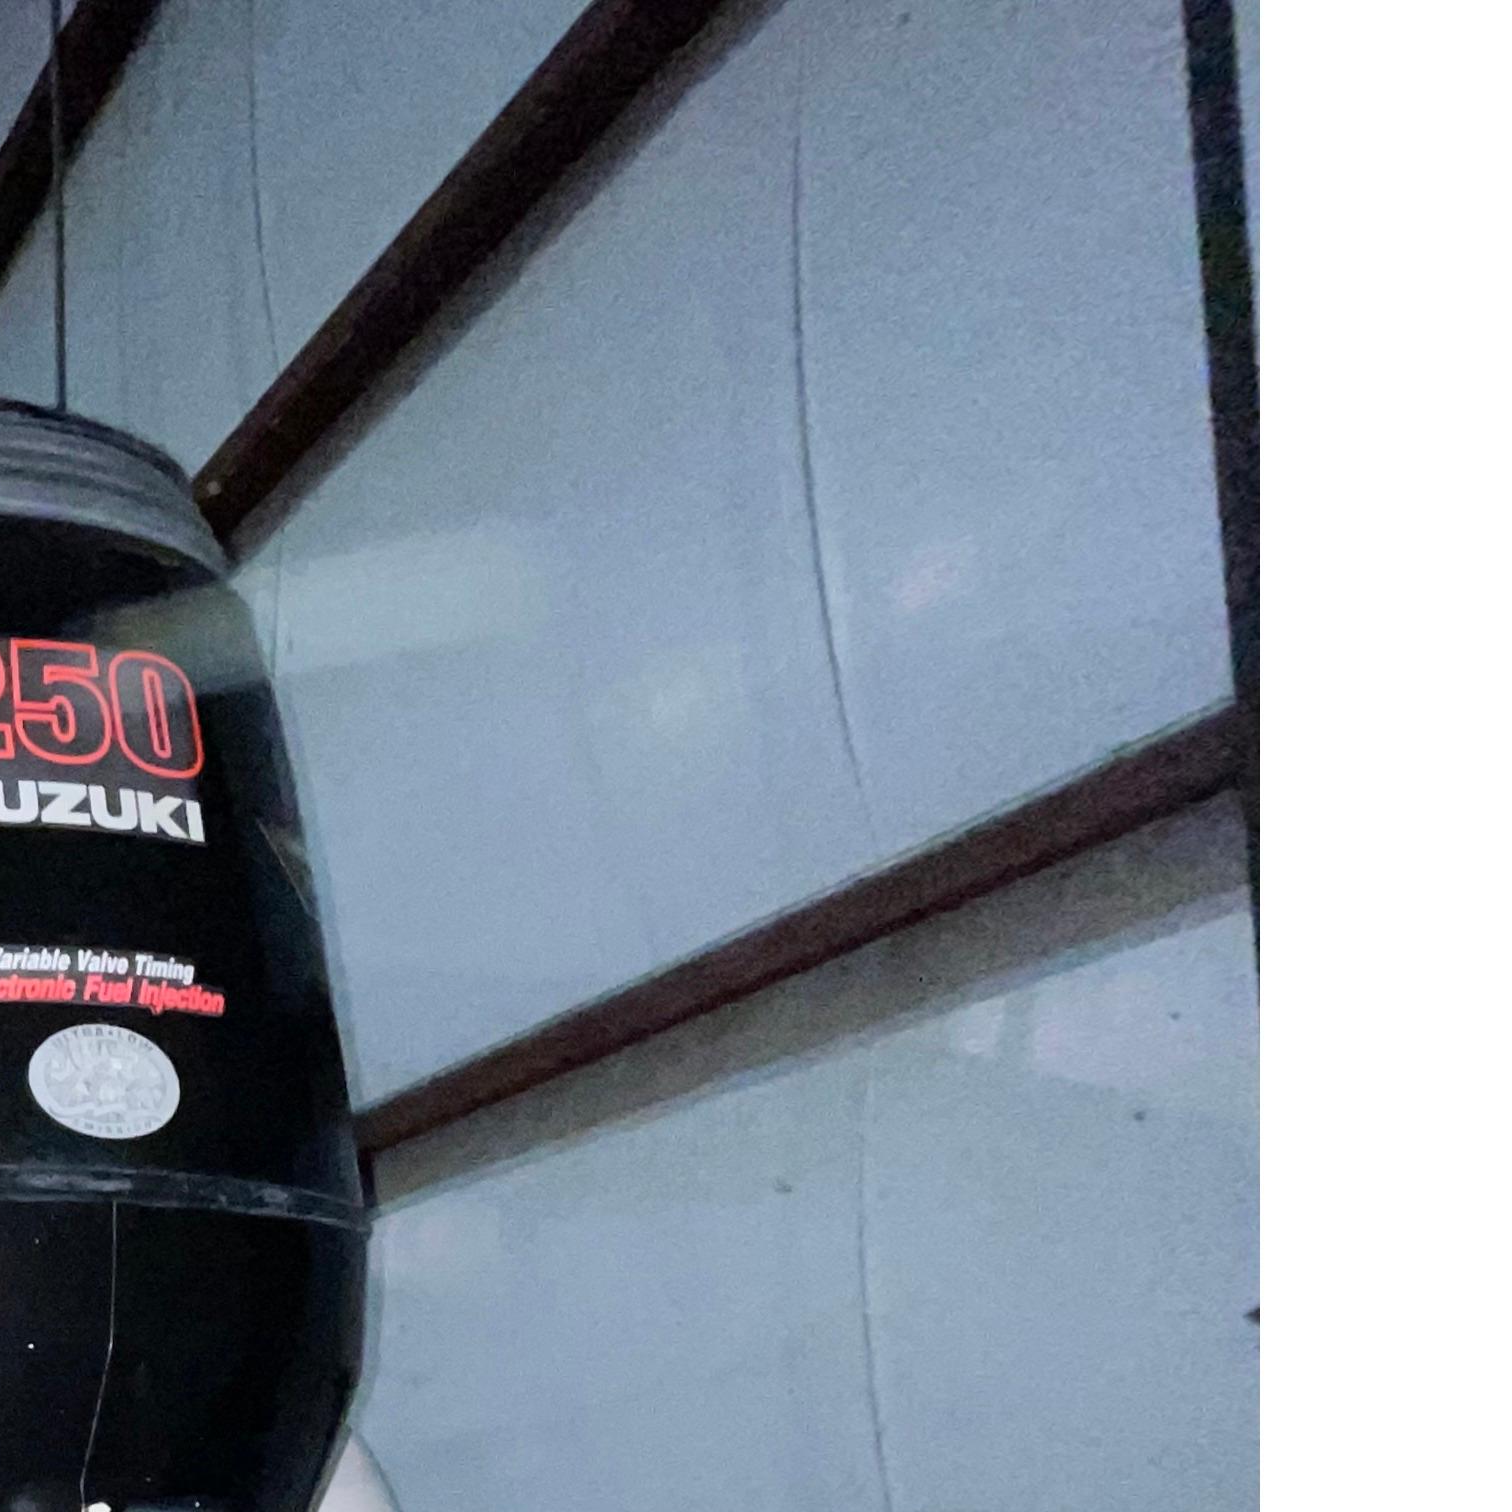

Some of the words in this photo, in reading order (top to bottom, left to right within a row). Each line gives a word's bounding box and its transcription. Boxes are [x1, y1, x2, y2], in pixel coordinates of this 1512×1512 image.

[77, 948, 128, 976] Valve
[134, 953, 195, 985] Timing
[83, 973, 134, 1003] Fuel
[138, 979, 226, 1016] Injection
